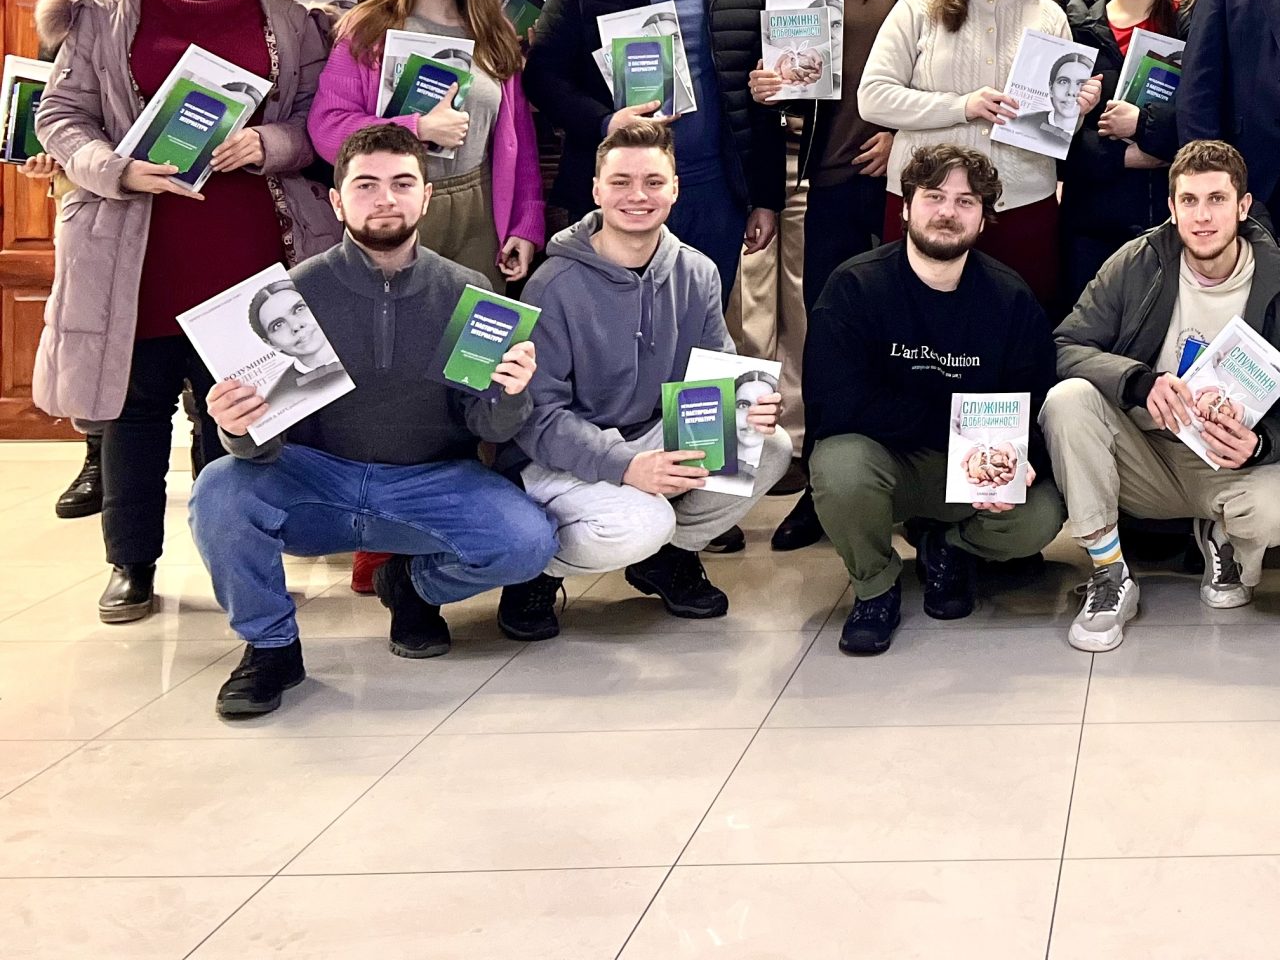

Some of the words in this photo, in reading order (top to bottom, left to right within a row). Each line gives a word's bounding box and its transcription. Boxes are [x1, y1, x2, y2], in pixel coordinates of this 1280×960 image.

[770, 14, 819, 27] СЛУЖІННЯ
[890, 342, 918, 360] L'art
[1229, 346, 1276, 391] СЛУЖІННЯ
[1221, 358, 1267, 400] ДОБРОЧИННОСТІ
[962, 400, 1018, 414] СЛУЖІННЯ
[962, 416, 1018, 428] ДОБРОЧИННОСТІ
